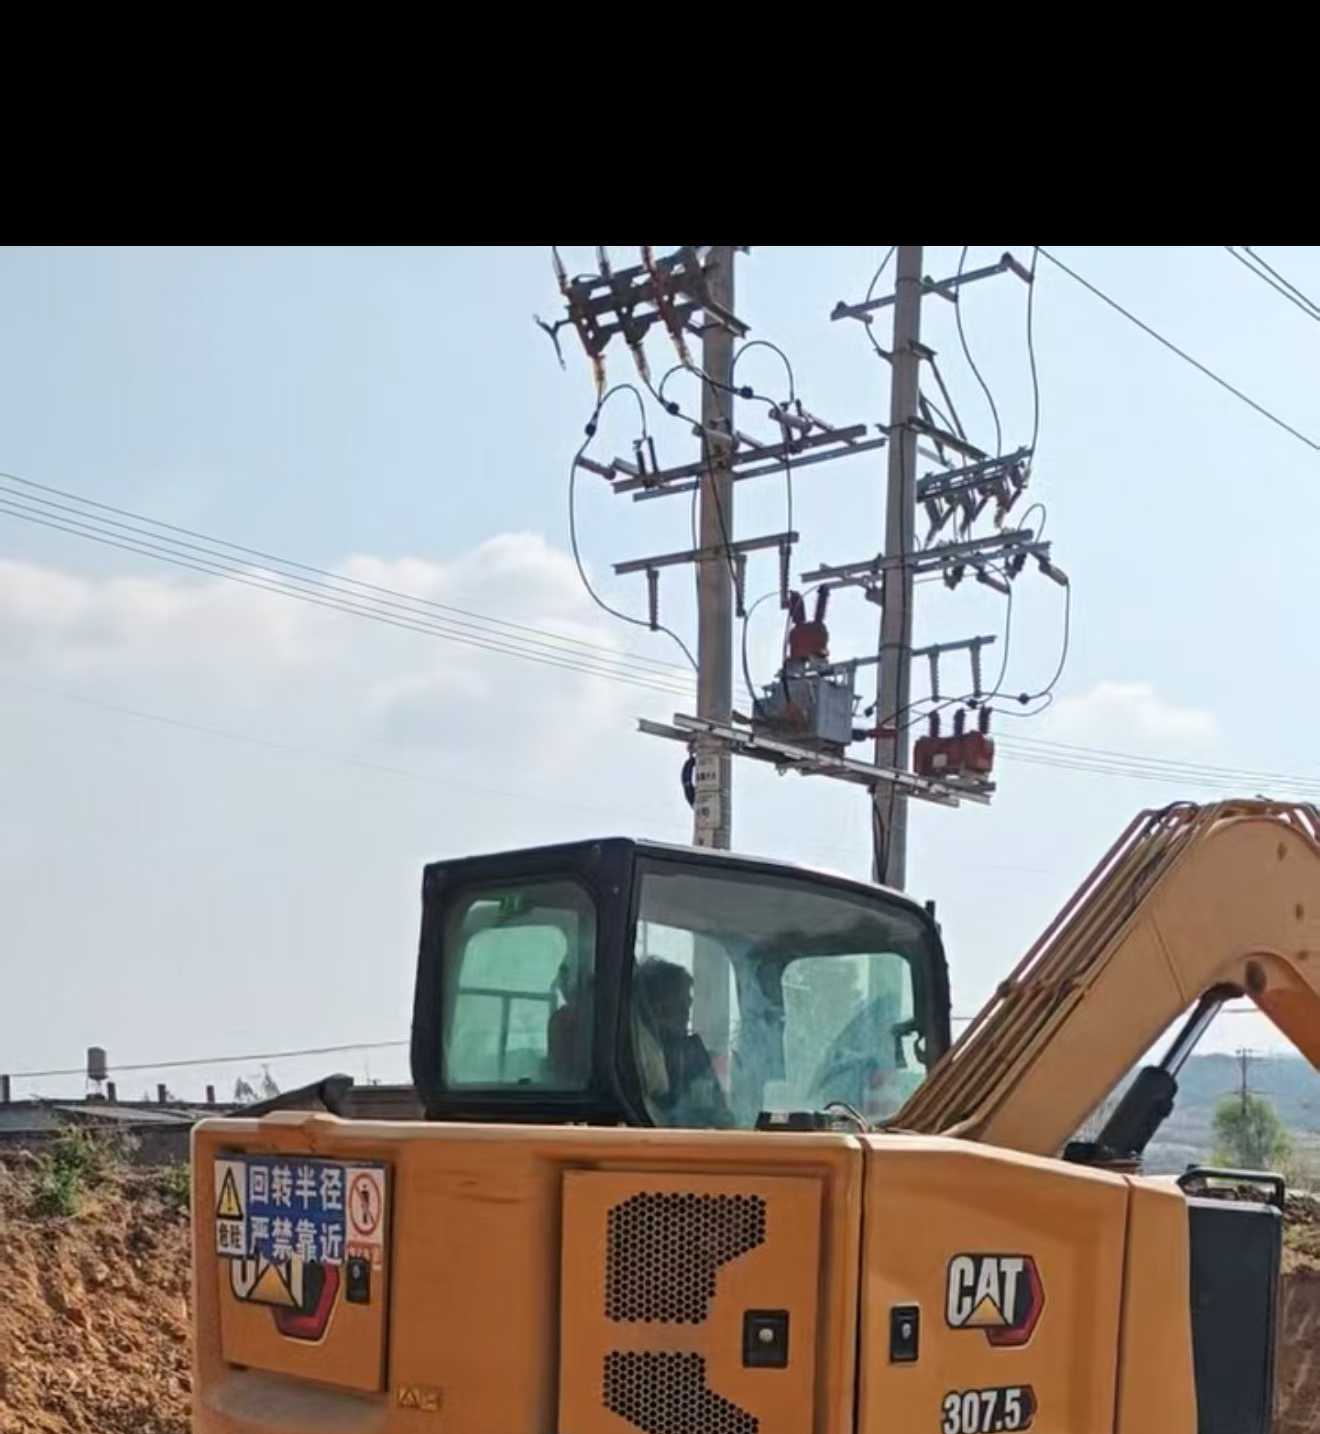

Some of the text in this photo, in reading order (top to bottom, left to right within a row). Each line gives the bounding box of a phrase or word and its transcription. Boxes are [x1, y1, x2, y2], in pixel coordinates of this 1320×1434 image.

[249, 1165, 342, 1211] 回转半径
[219, 1222, 242, 1250] 危险
[249, 1216, 342, 1264] 严禁靠近
[948, 1256, 1024, 1327] CAT
